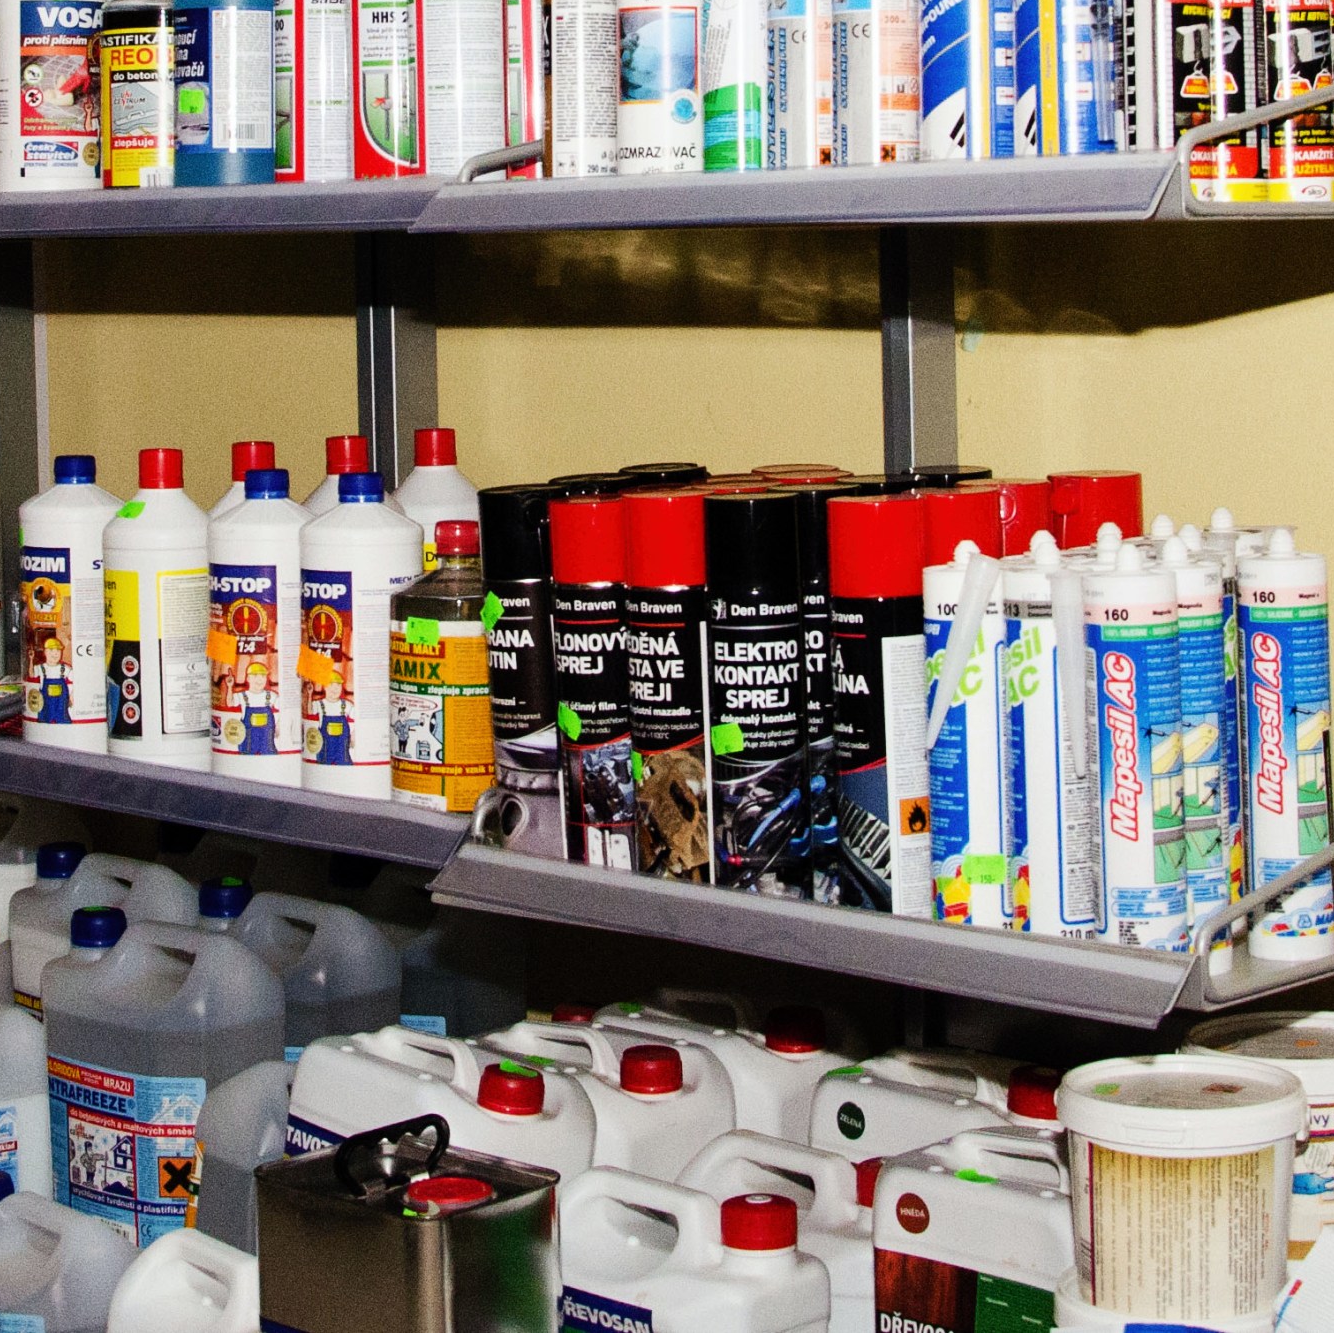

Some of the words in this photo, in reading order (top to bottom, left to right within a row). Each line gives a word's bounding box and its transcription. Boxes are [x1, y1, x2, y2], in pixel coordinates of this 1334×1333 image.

[23, 35, 49, 47] proti
[51, 34, 88, 47] plísním
[113, 72, 125, 82] do
[114, 138, 155, 148] zlepšuje
[1251, 590, 1276, 604] 160
[555, 599, 571, 611] Den
[573, 599, 617, 612] Braven
[640, 602, 683, 614] Braven
[730, 605, 756, 617] Den
[759, 602, 798, 617] Braven
[1103, 608, 1129, 622] 160
[237, 641, 257, 654] 1:4
[714, 639, 798, 662] ELEKTRO
[1252, 631, 1283, 690] AC
[657, 659, 685, 679] VE
[714, 662, 800, 685] KONTAKT
[1103, 651, 1137, 712] AC
[725, 687, 790, 709] SPREJ
[598, 701, 617, 712] film
[653, 706, 692, 717] mazadlo
[720, 714, 760, 727] dokonalý
[762, 711, 797, 724] kontakt
[1254, 682, 1288, 816] Mapesil
[1105, 703, 1139, 843] Mapesil
[103, 1076, 131, 1093] MRAZU
[123, 1123, 165, 1136] maltových
[899, 1206, 927, 1219] HNĚDÁ
